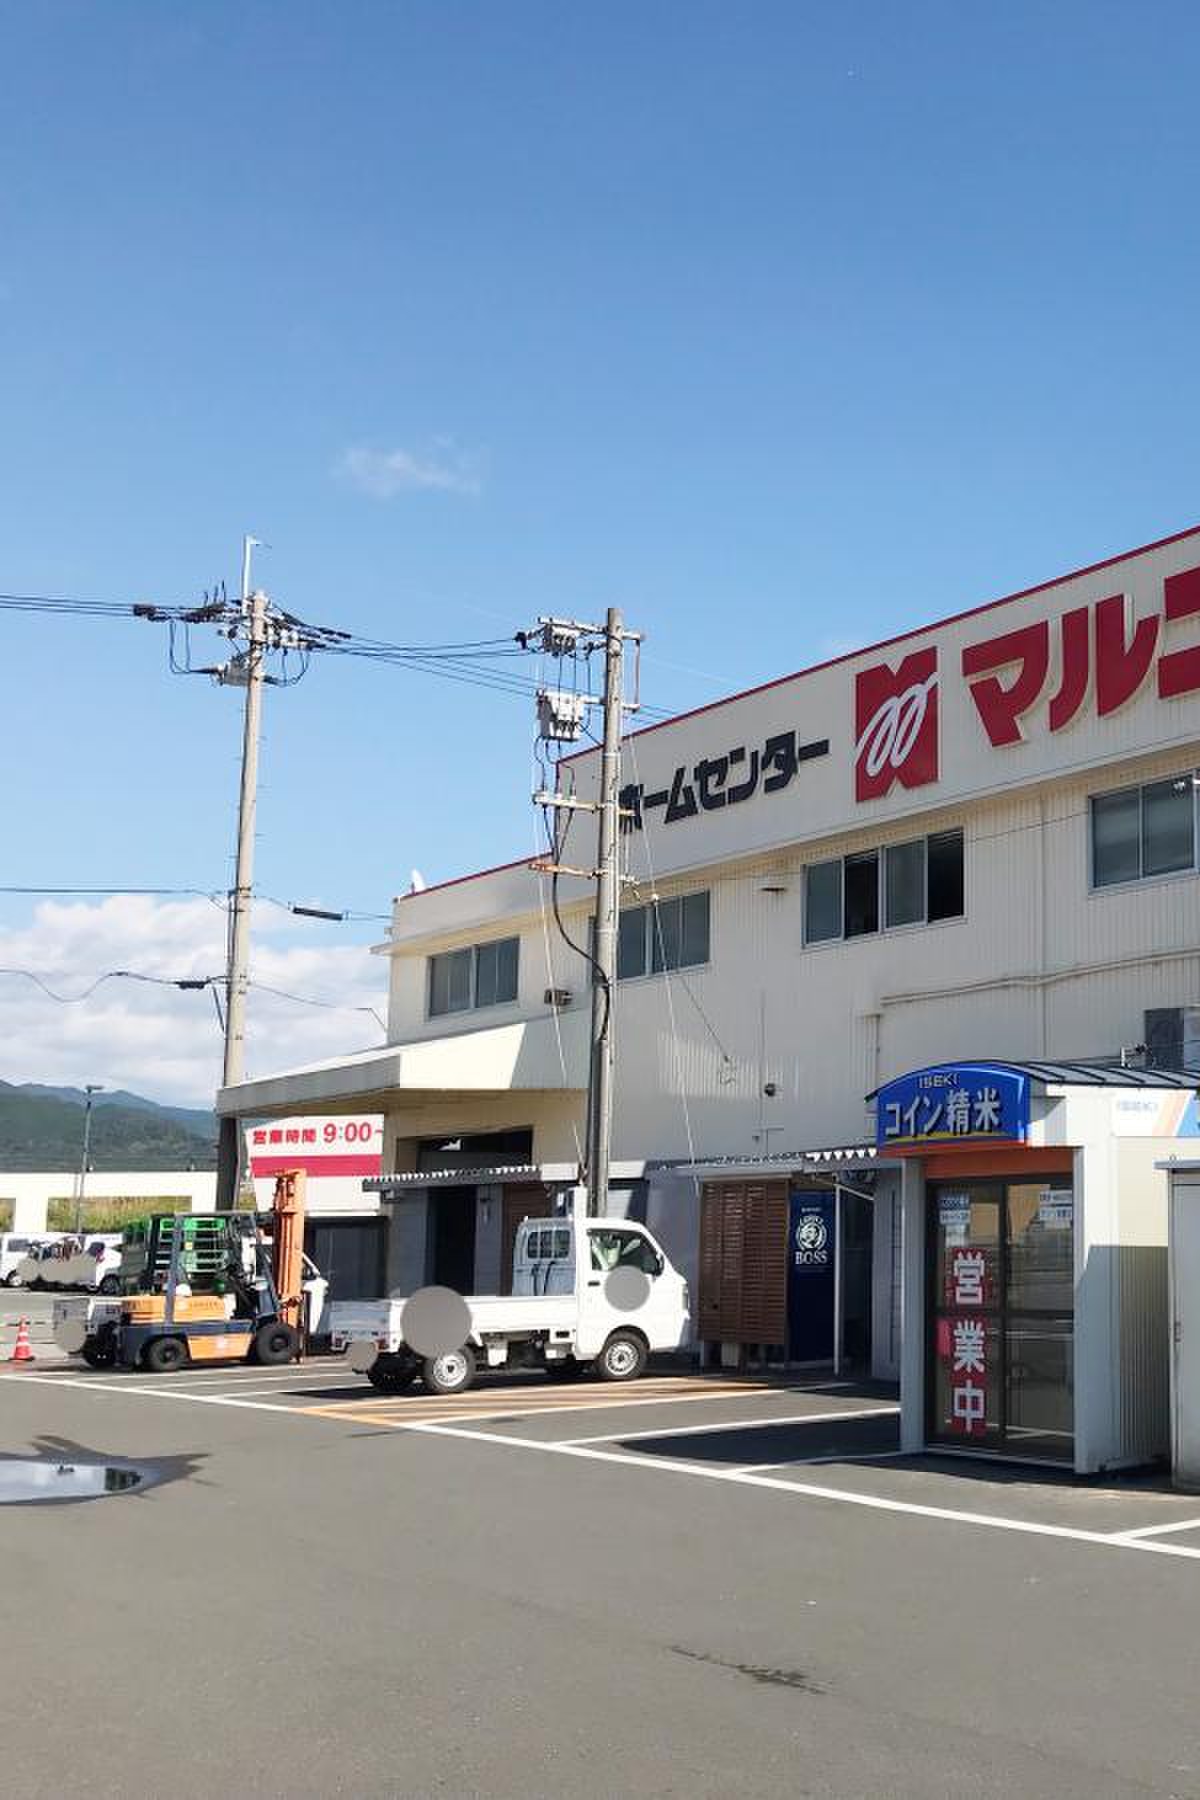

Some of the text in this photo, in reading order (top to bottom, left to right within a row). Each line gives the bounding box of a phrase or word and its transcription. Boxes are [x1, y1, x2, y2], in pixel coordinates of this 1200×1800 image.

[619, 730, 829, 834] ホームセンター
[885, 1088, 1000, 1138] コイン精米
[795, 1250, 828, 1265] BOSS
[953, 1251, 985, 1432] 営業中
